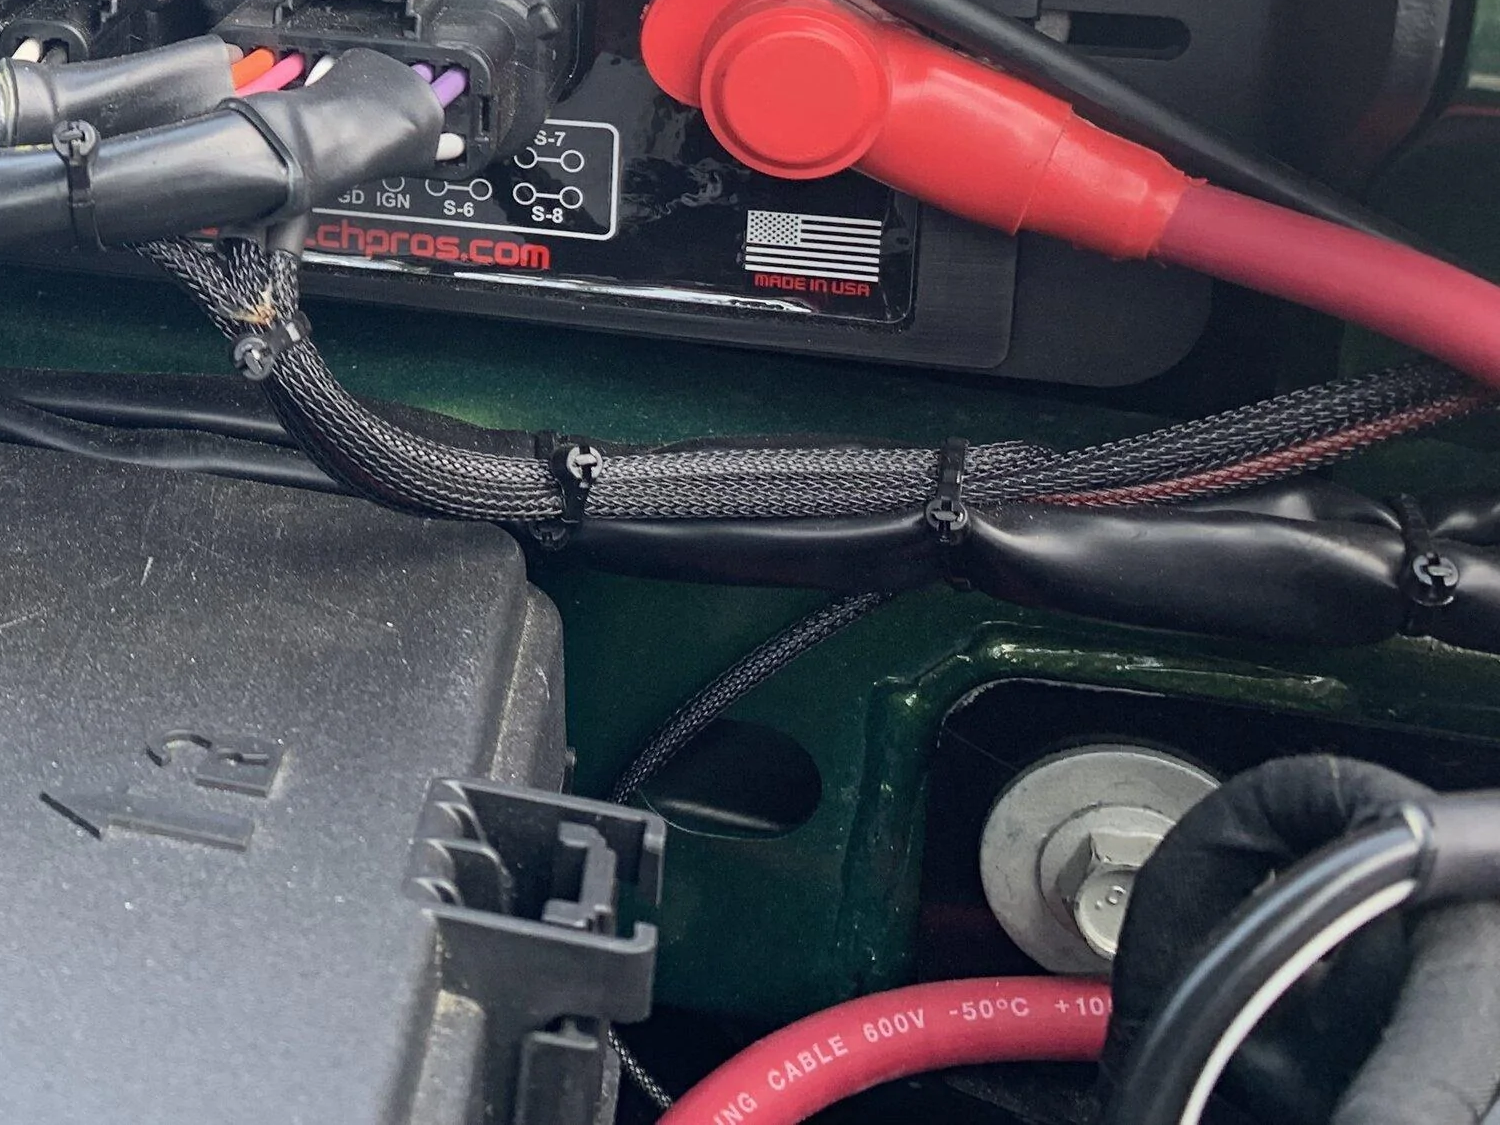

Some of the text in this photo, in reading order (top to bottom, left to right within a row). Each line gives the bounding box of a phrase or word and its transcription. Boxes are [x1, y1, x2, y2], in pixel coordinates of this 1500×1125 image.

[533, 130, 567, 147] S-7
[376, 191, 411, 209] IGN
[442, 200, 475, 218] S-6
[531, 205, 564, 224] S-8
[754, 274, 871, 297] MADE IN USA
[767, 1035, 849, 1091] CABLE
[862, 1008, 926, 1043] 600V
